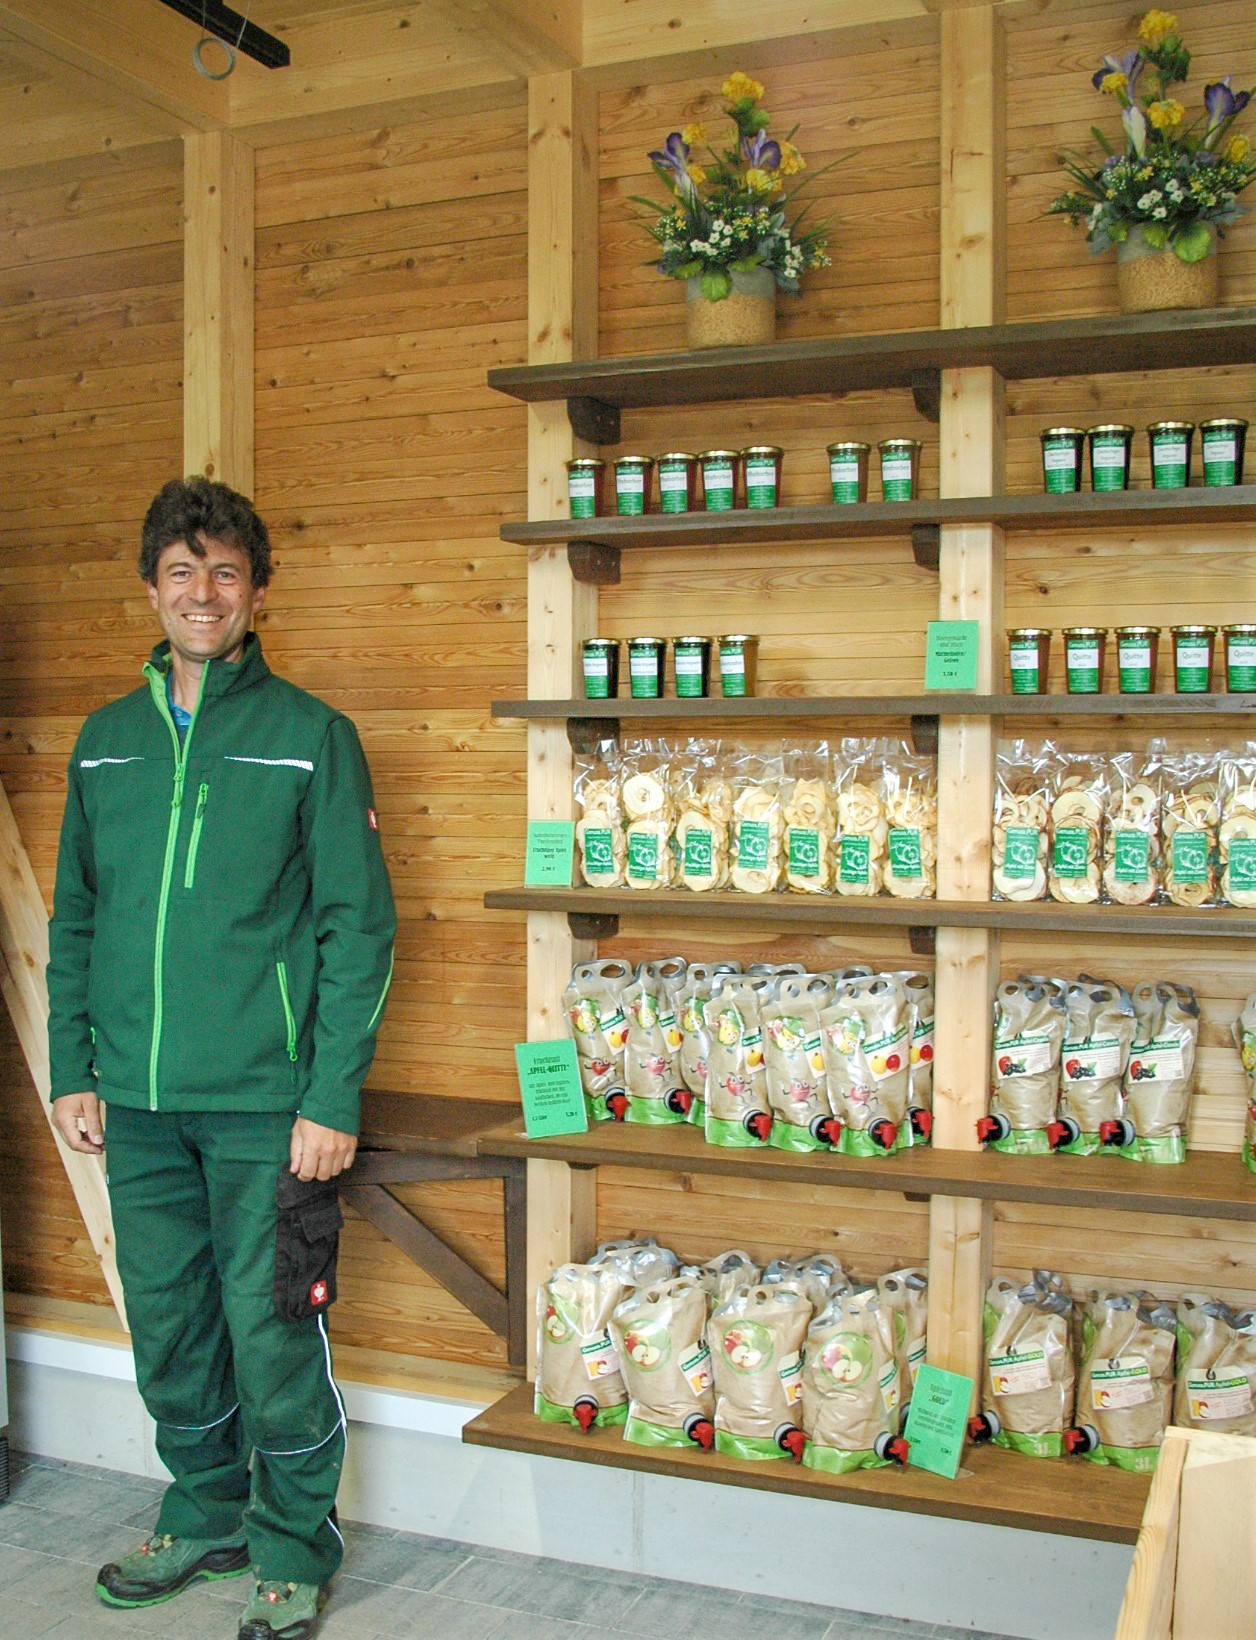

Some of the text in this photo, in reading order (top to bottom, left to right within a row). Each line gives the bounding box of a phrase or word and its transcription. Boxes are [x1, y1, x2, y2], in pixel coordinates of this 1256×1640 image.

[1013, 652, 1033, 661] Quitte
[1072, 653, 1092, 662] Quitte
[1124, 652, 1143, 661] Quitte
[1181, 651, 1202, 660] Quitte
